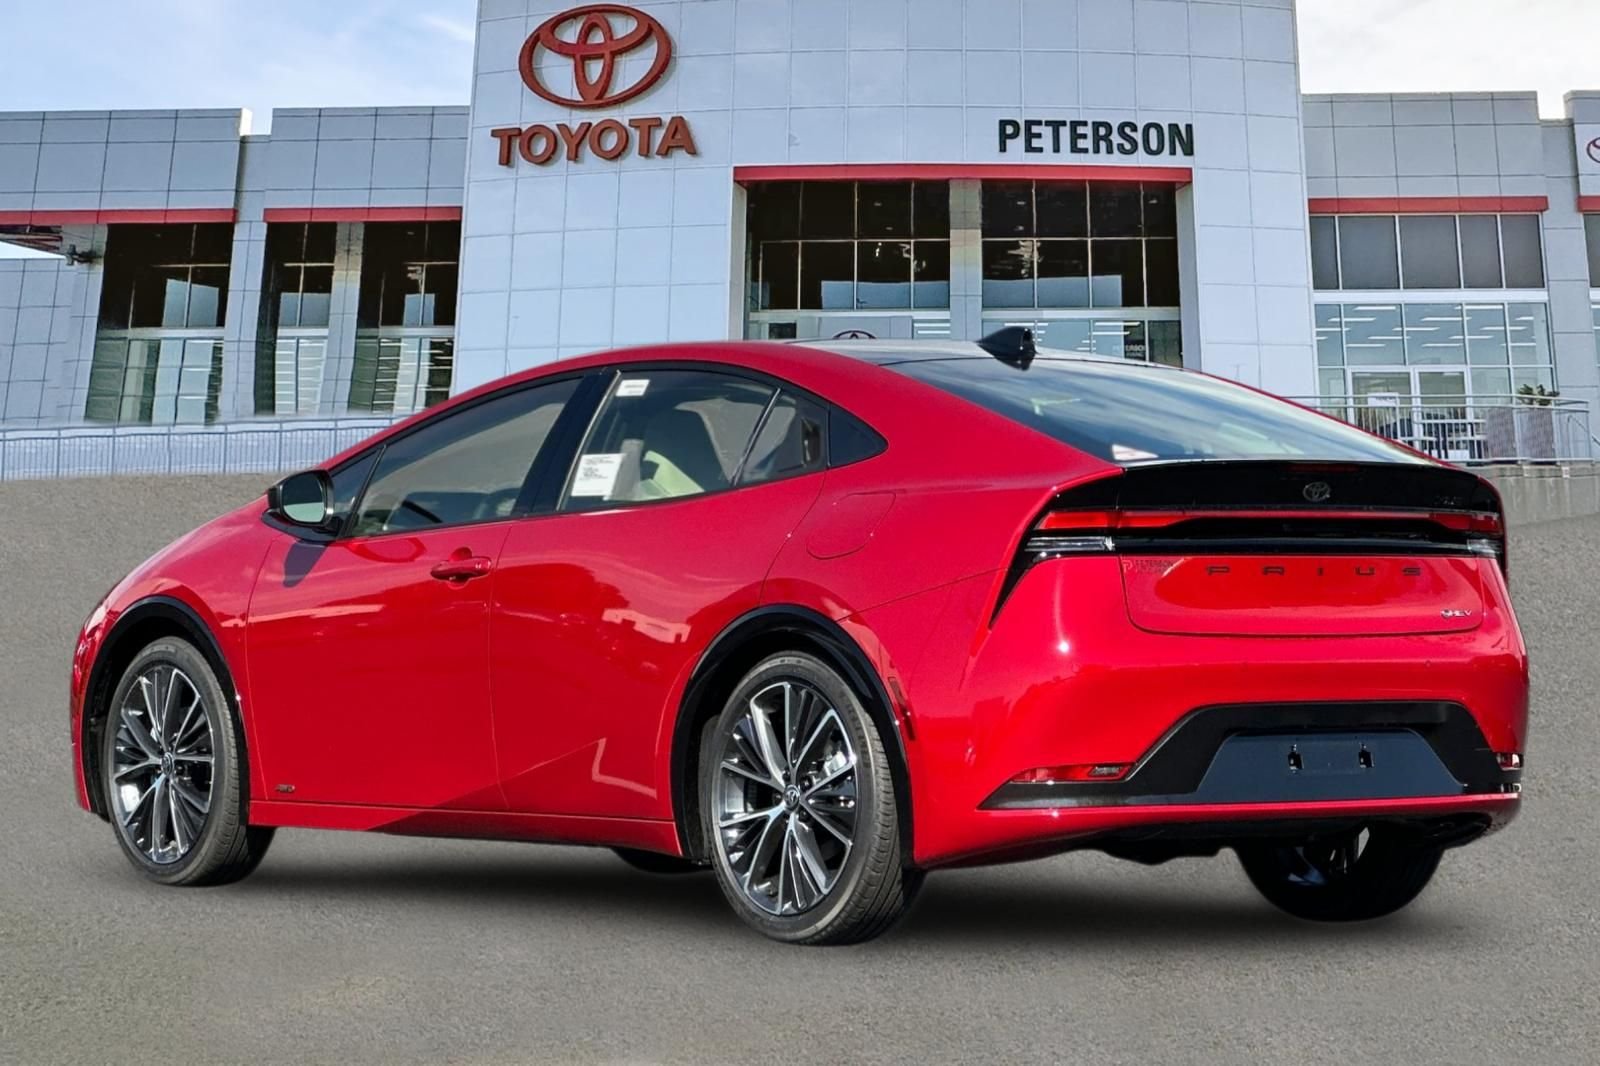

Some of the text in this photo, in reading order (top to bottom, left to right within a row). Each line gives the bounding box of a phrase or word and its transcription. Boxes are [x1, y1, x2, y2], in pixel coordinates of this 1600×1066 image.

[490, 115, 697, 166] TOYOTA
[998, 119, 1194, 156] PETERSON
[1206, 565, 1420, 576] PRIUS
